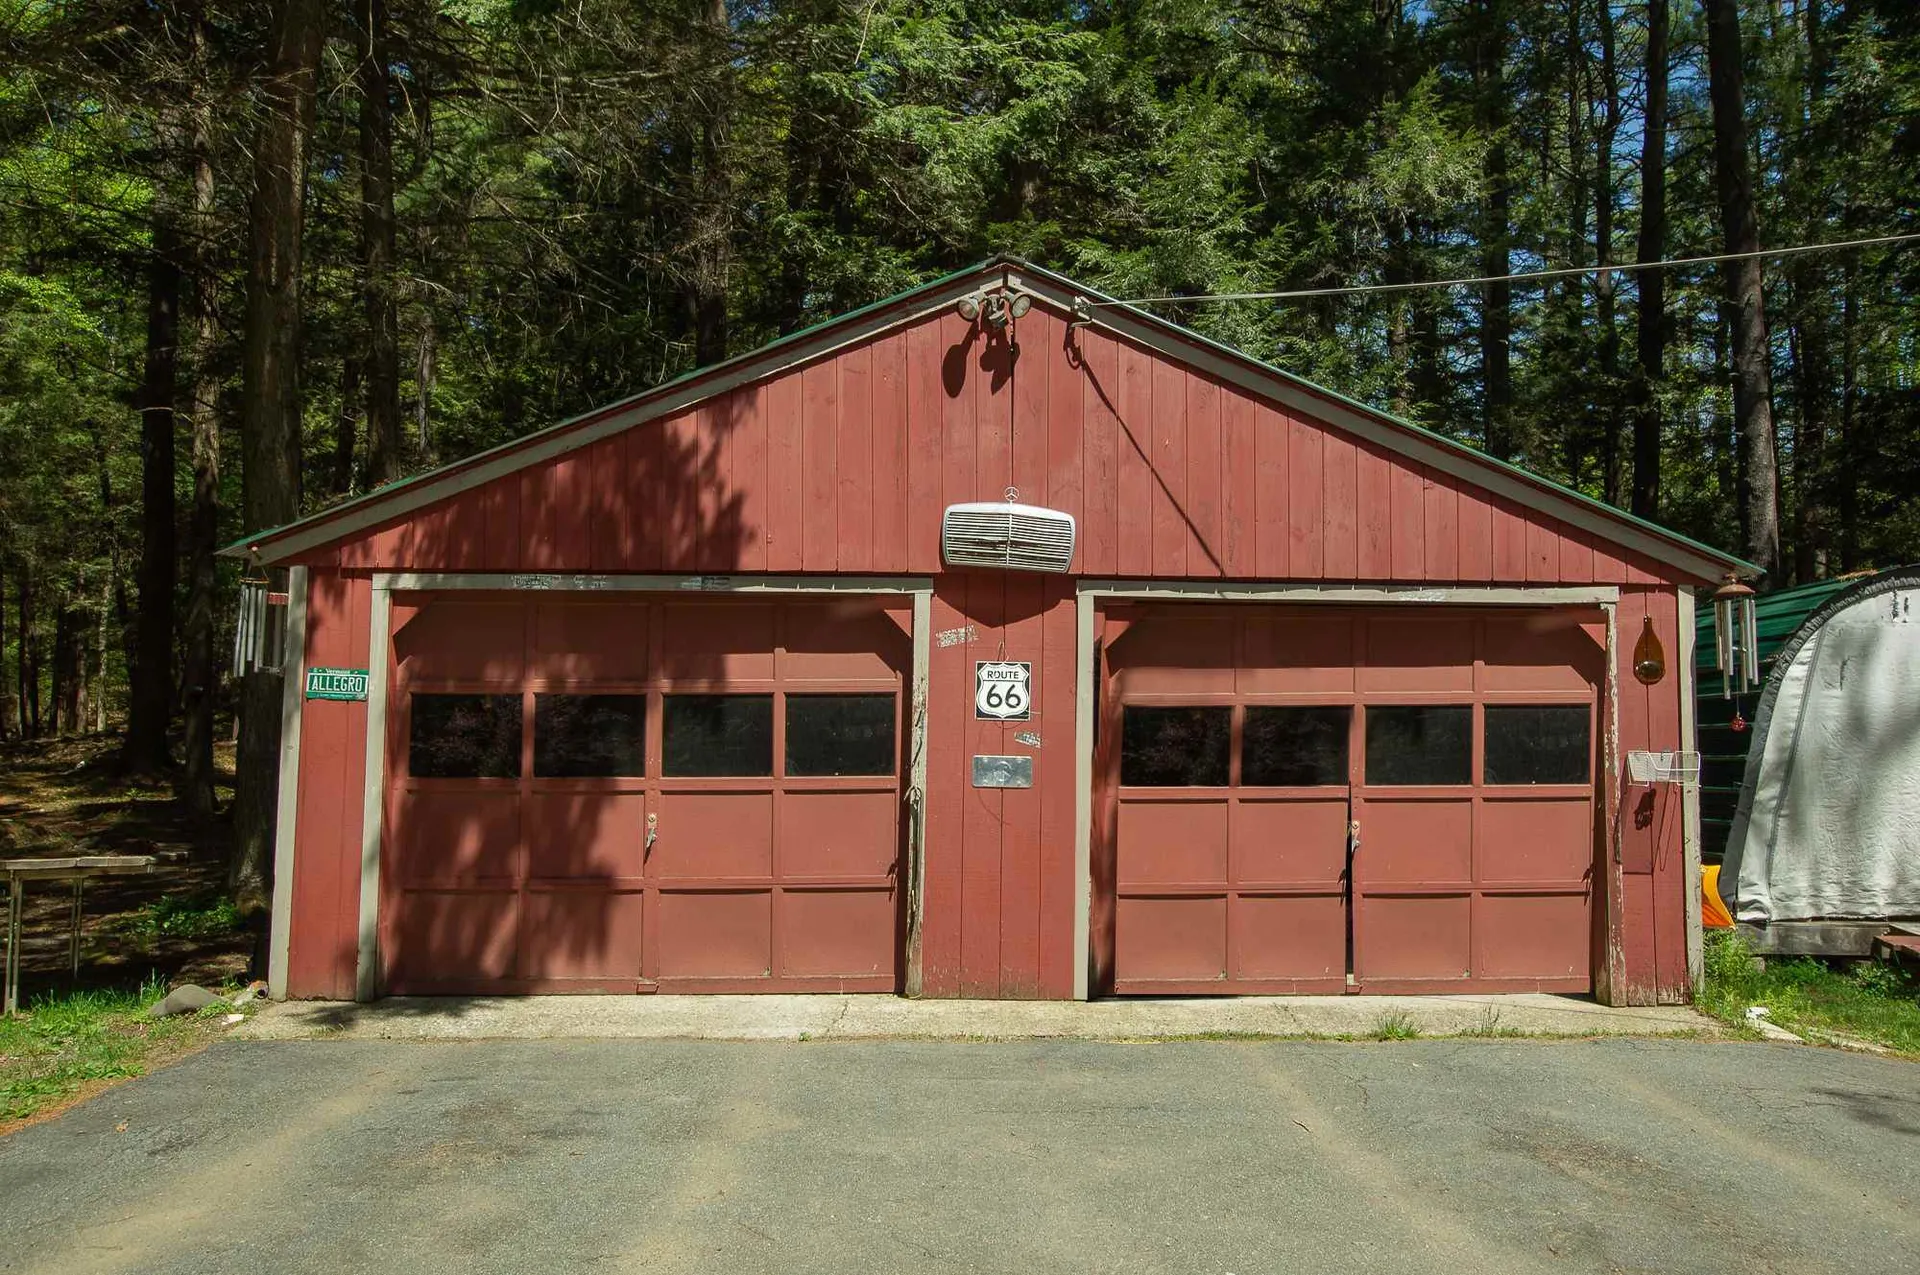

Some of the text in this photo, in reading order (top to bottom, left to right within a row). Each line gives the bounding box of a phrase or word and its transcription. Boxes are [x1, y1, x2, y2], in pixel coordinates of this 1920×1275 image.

[987, 670, 1020, 680] ROUTE
[312, 676, 362, 691] ALLEGRO
[986, 683, 1022, 709] 66
